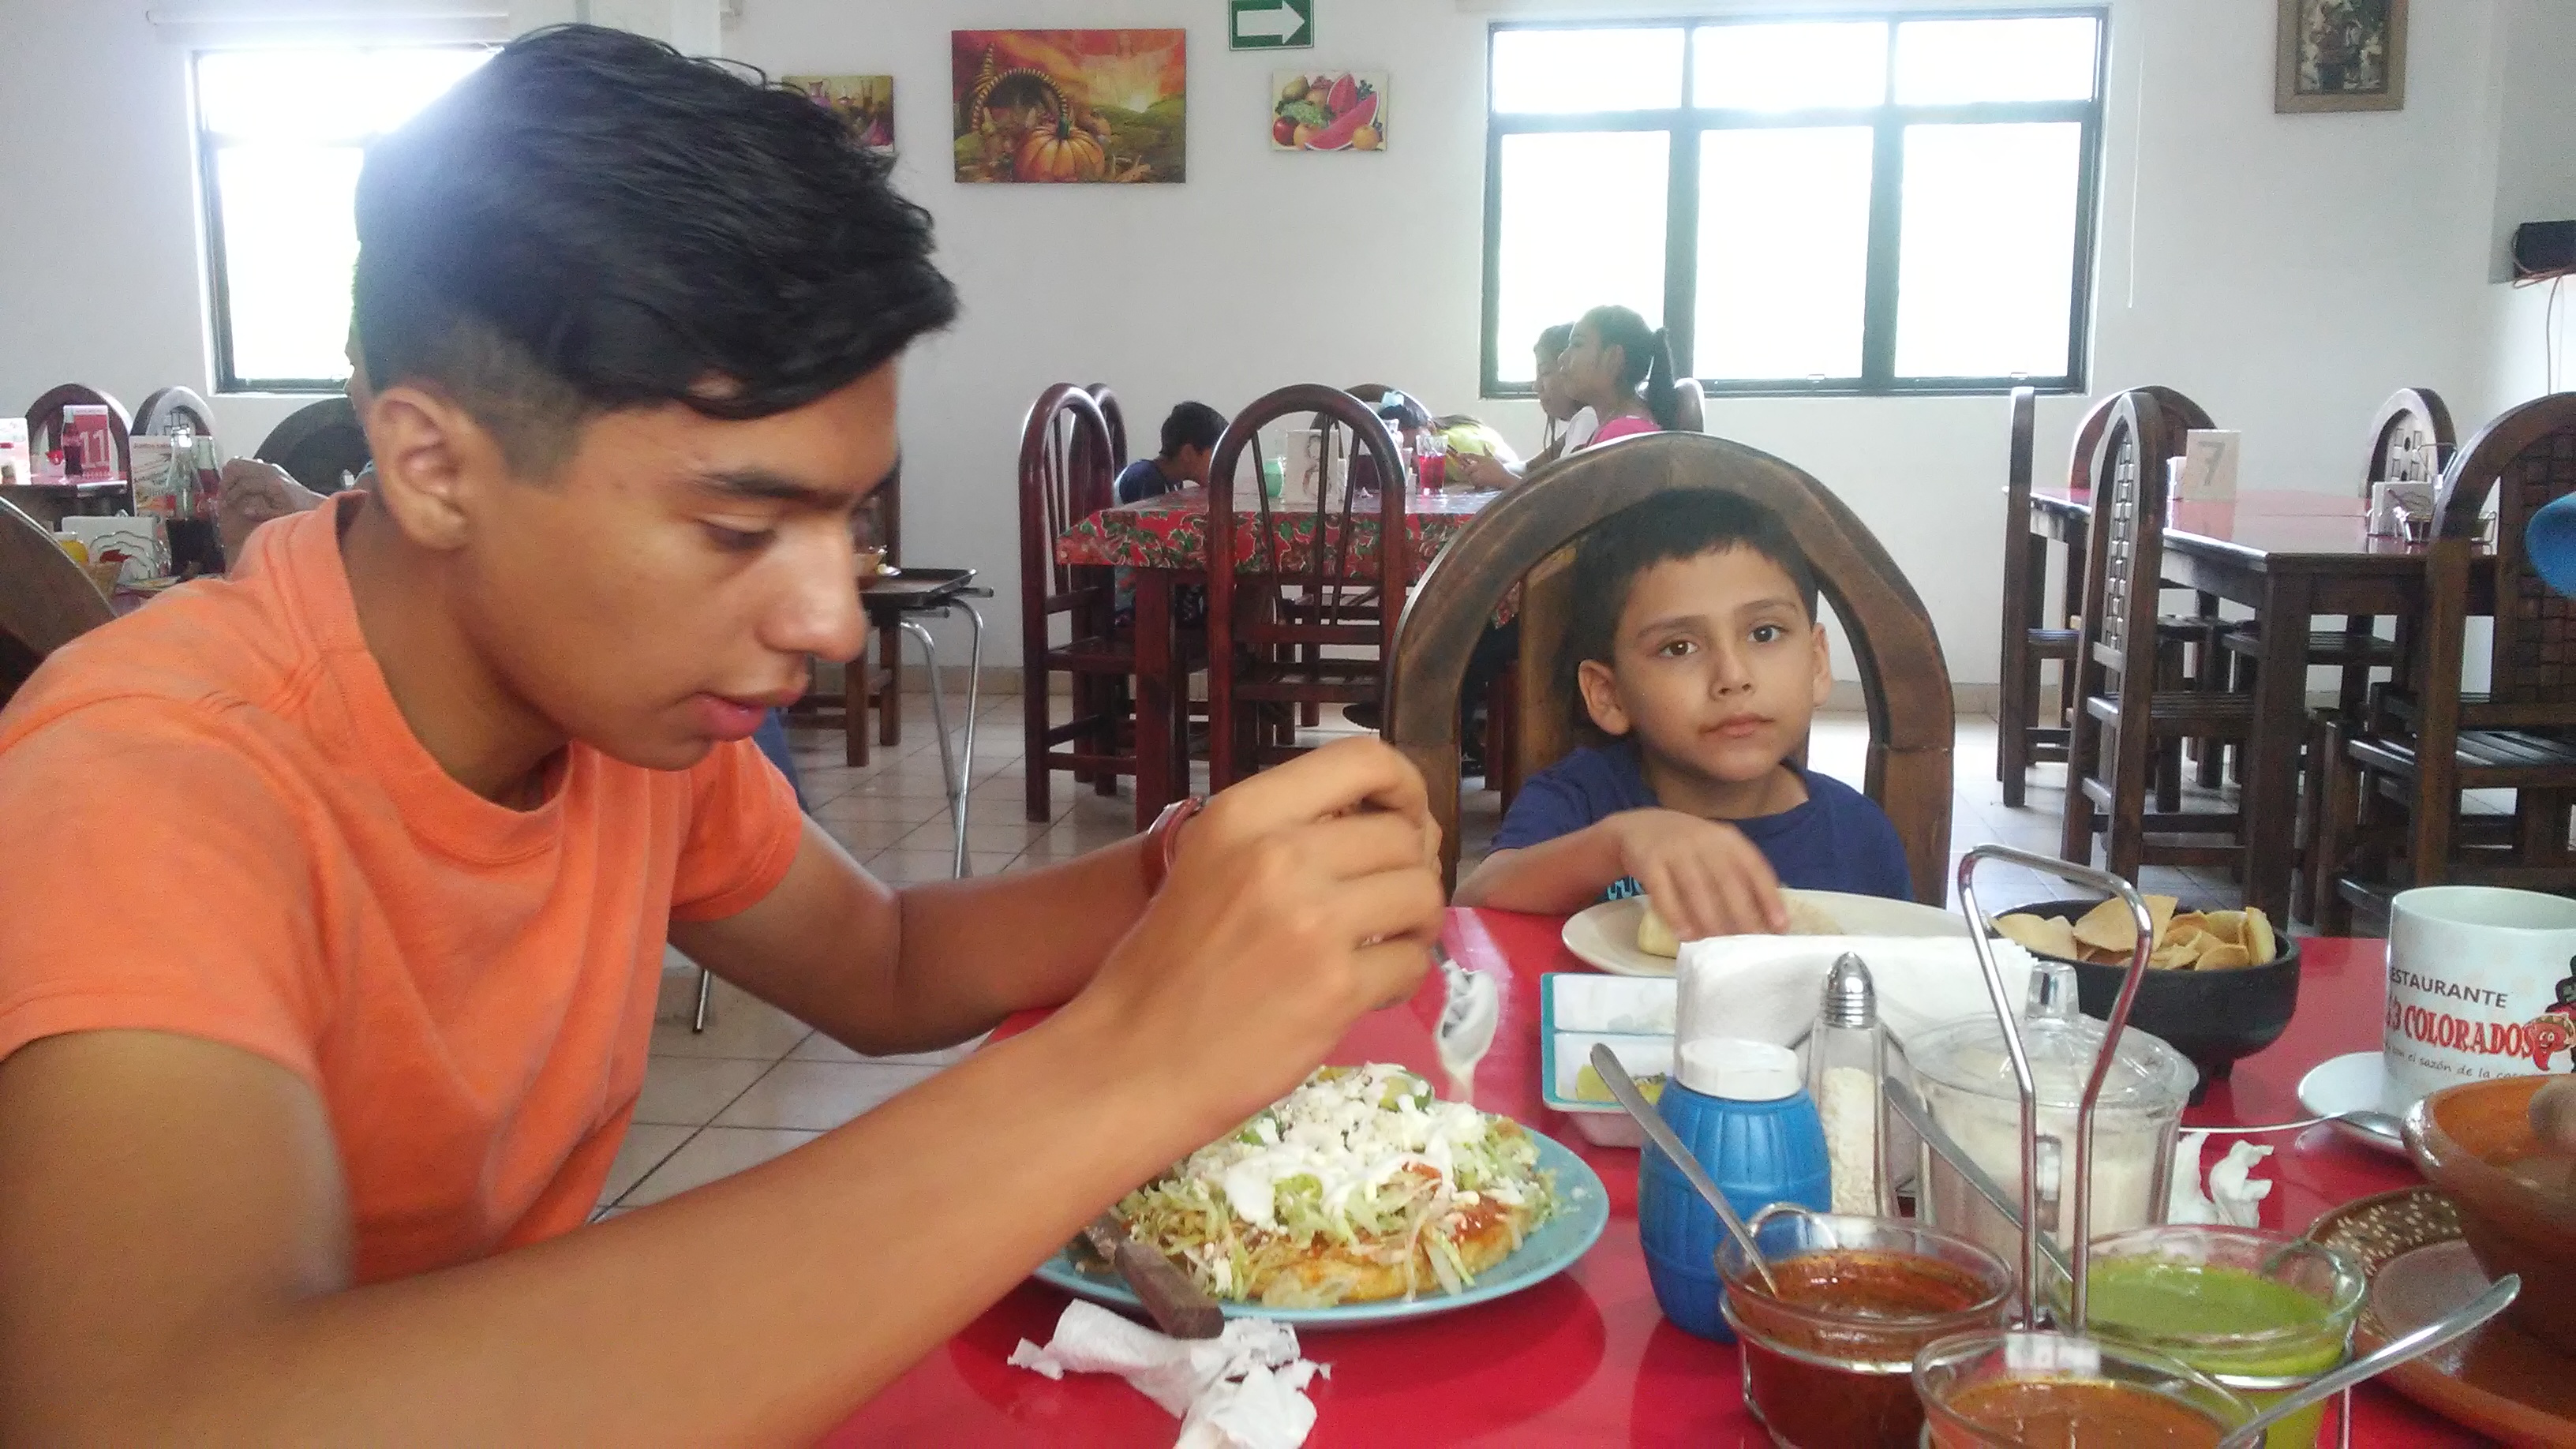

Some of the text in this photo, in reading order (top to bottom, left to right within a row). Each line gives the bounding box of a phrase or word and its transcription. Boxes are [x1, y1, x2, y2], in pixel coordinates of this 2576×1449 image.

[80, 430, 110, 469] 11
[2197, 441, 2225, 486] 7
[2390, 967, 2508, 1009] ESTAURANTE
[2405, 1004, 2535, 1059] COLORADOS
[2456, 1065, 2473, 1076] de
[2478, 1068, 2490, 1078] la
